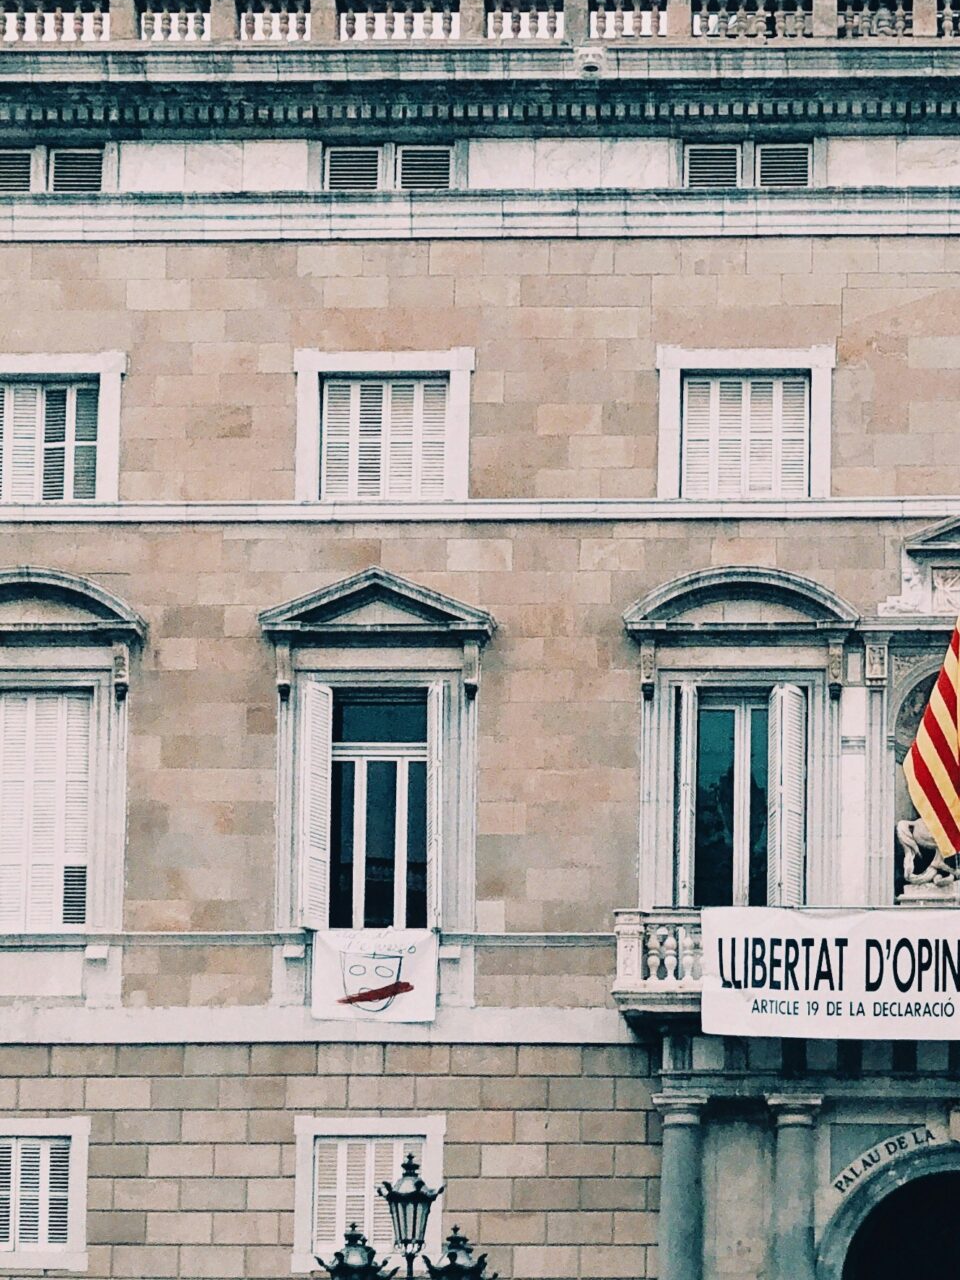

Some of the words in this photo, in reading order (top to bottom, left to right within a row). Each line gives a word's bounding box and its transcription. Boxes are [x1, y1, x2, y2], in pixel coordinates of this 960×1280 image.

[717, 937, 849, 992] LLIBERTAT
[751, 999, 799, 1017] ARTICLE
[806, 1001, 819, 1016] 19
[826, 1001, 842, 1017] DE
[849, 1001, 866, 1017] LA
[873, 998, 955, 1018] DECLARACIÓ
[834, 1151, 882, 1194] PALAU
[884, 1136, 909, 1154] DE
[914, 1128, 936, 1144] LA
